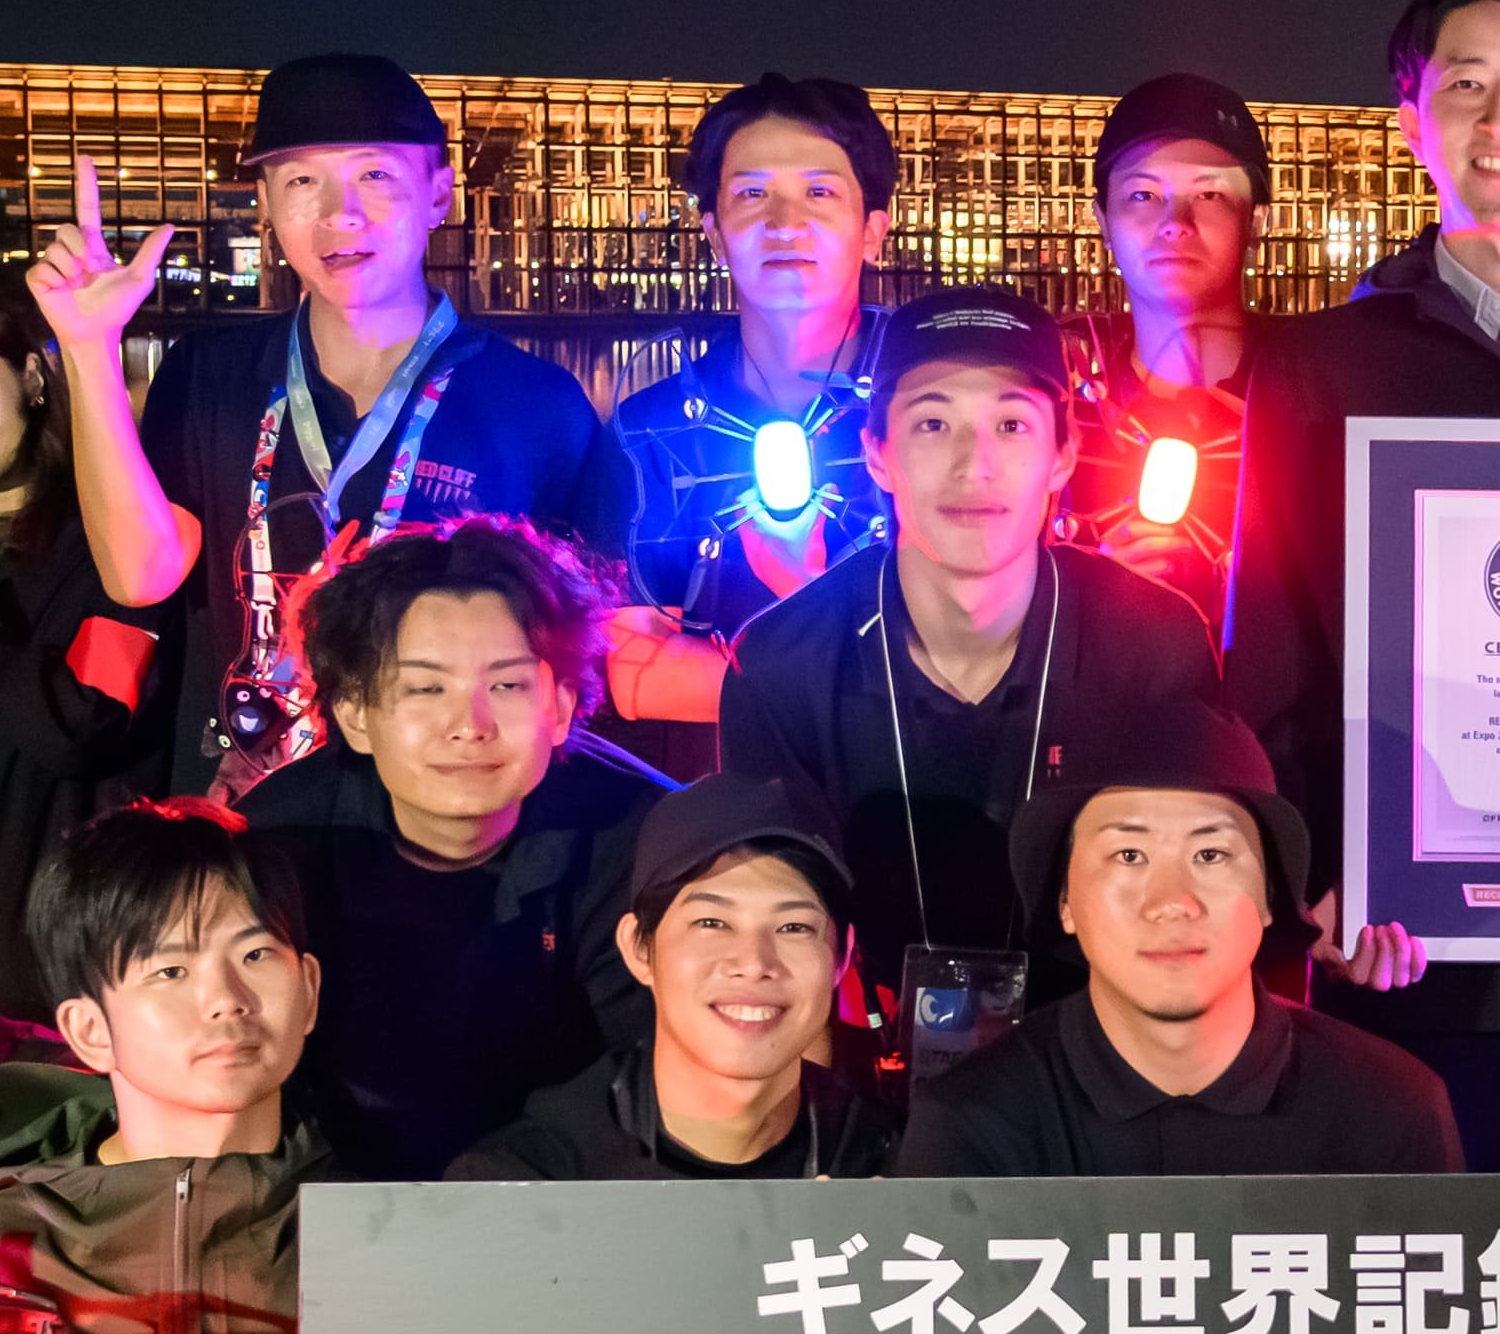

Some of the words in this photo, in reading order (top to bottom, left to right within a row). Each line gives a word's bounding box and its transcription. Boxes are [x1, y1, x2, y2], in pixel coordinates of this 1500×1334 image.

[1477, 674, 1493, 684] The
[1461, 731, 1471, 740] at
[1473, 731, 1495, 742] Expo
